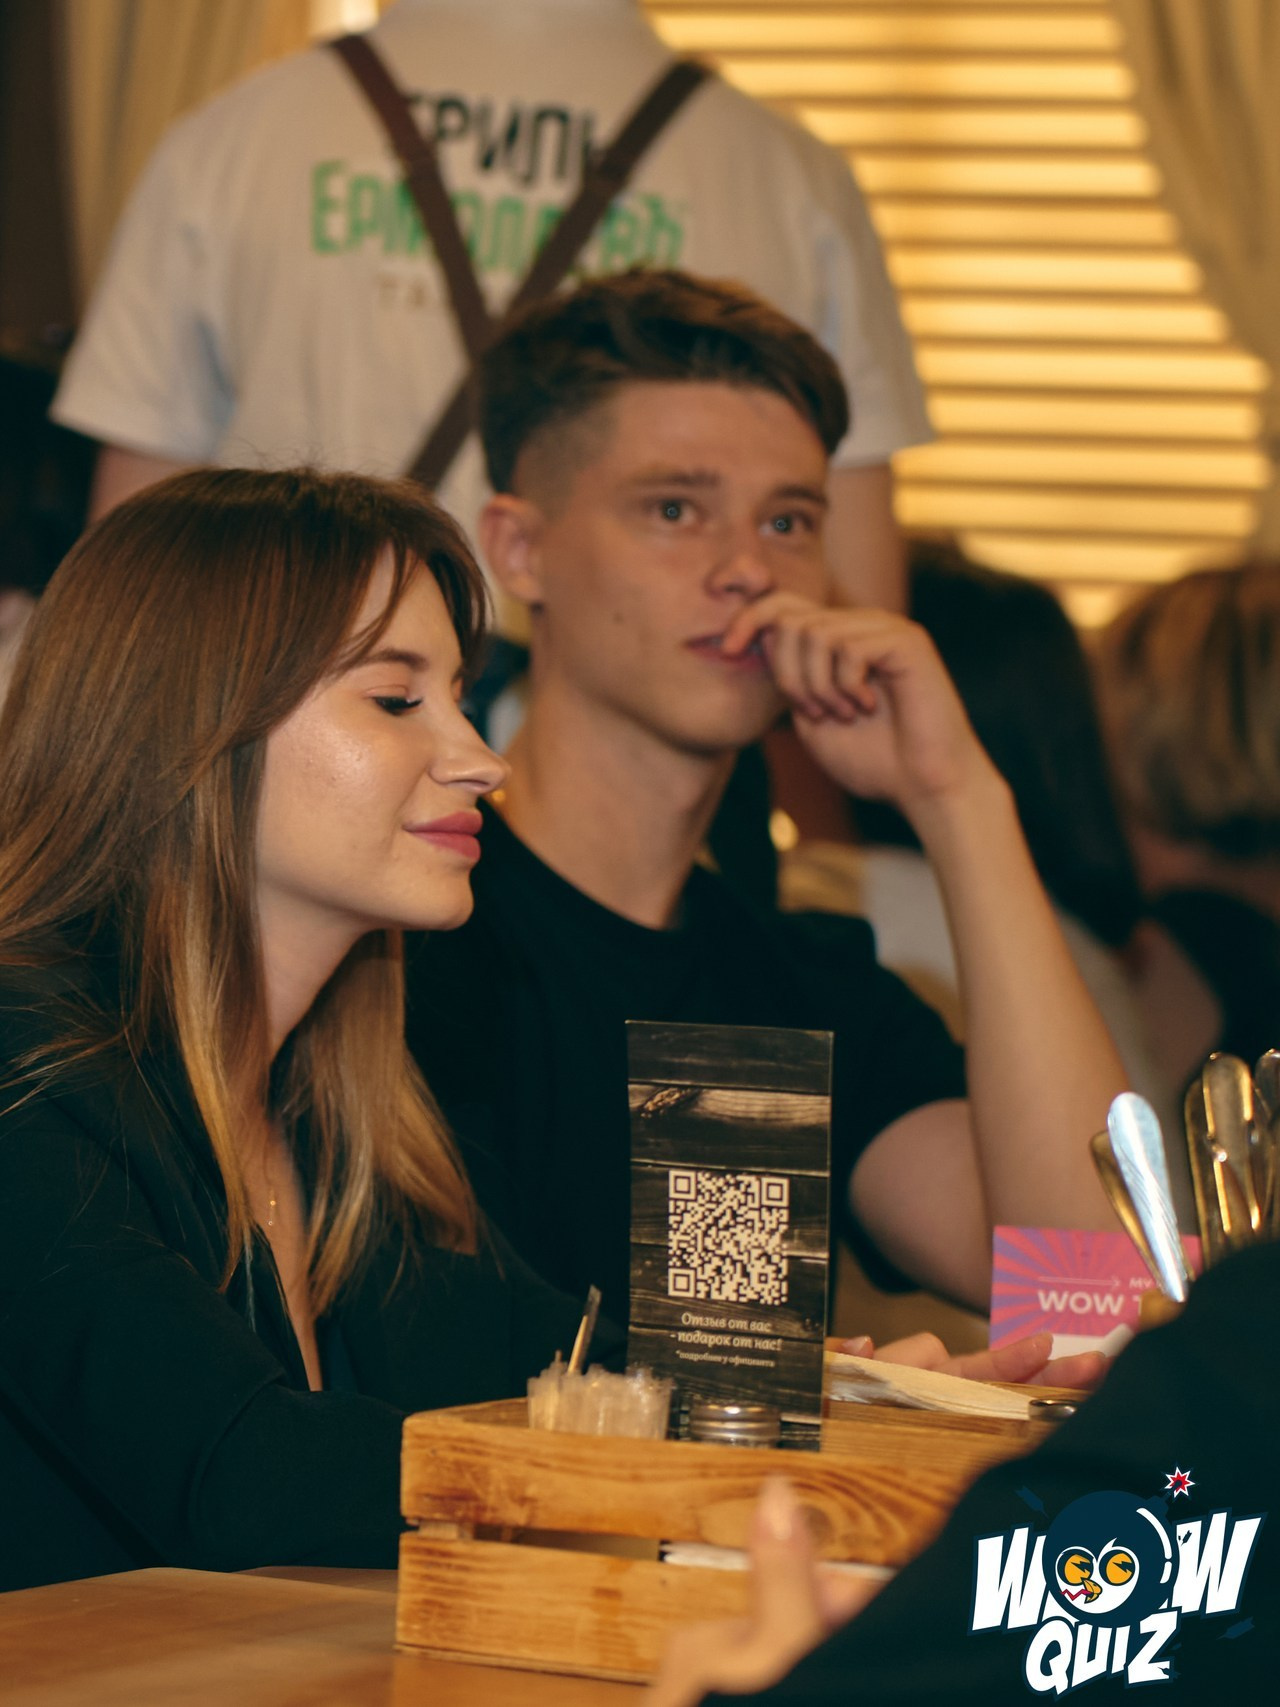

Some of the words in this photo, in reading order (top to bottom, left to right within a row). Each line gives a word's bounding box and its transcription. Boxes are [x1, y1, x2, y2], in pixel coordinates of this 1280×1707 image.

[397, 91, 598, 188] РИЛ
[1037, 1290, 1124, 1316] WOW
[681, 1312, 726, 1328] Отзыв
[728, 1318, 748, 1330] от
[749, 1321, 772, 1333] вас
[733, 1337, 752, 1349] от
[754, 1338, 783, 1351] нас!
